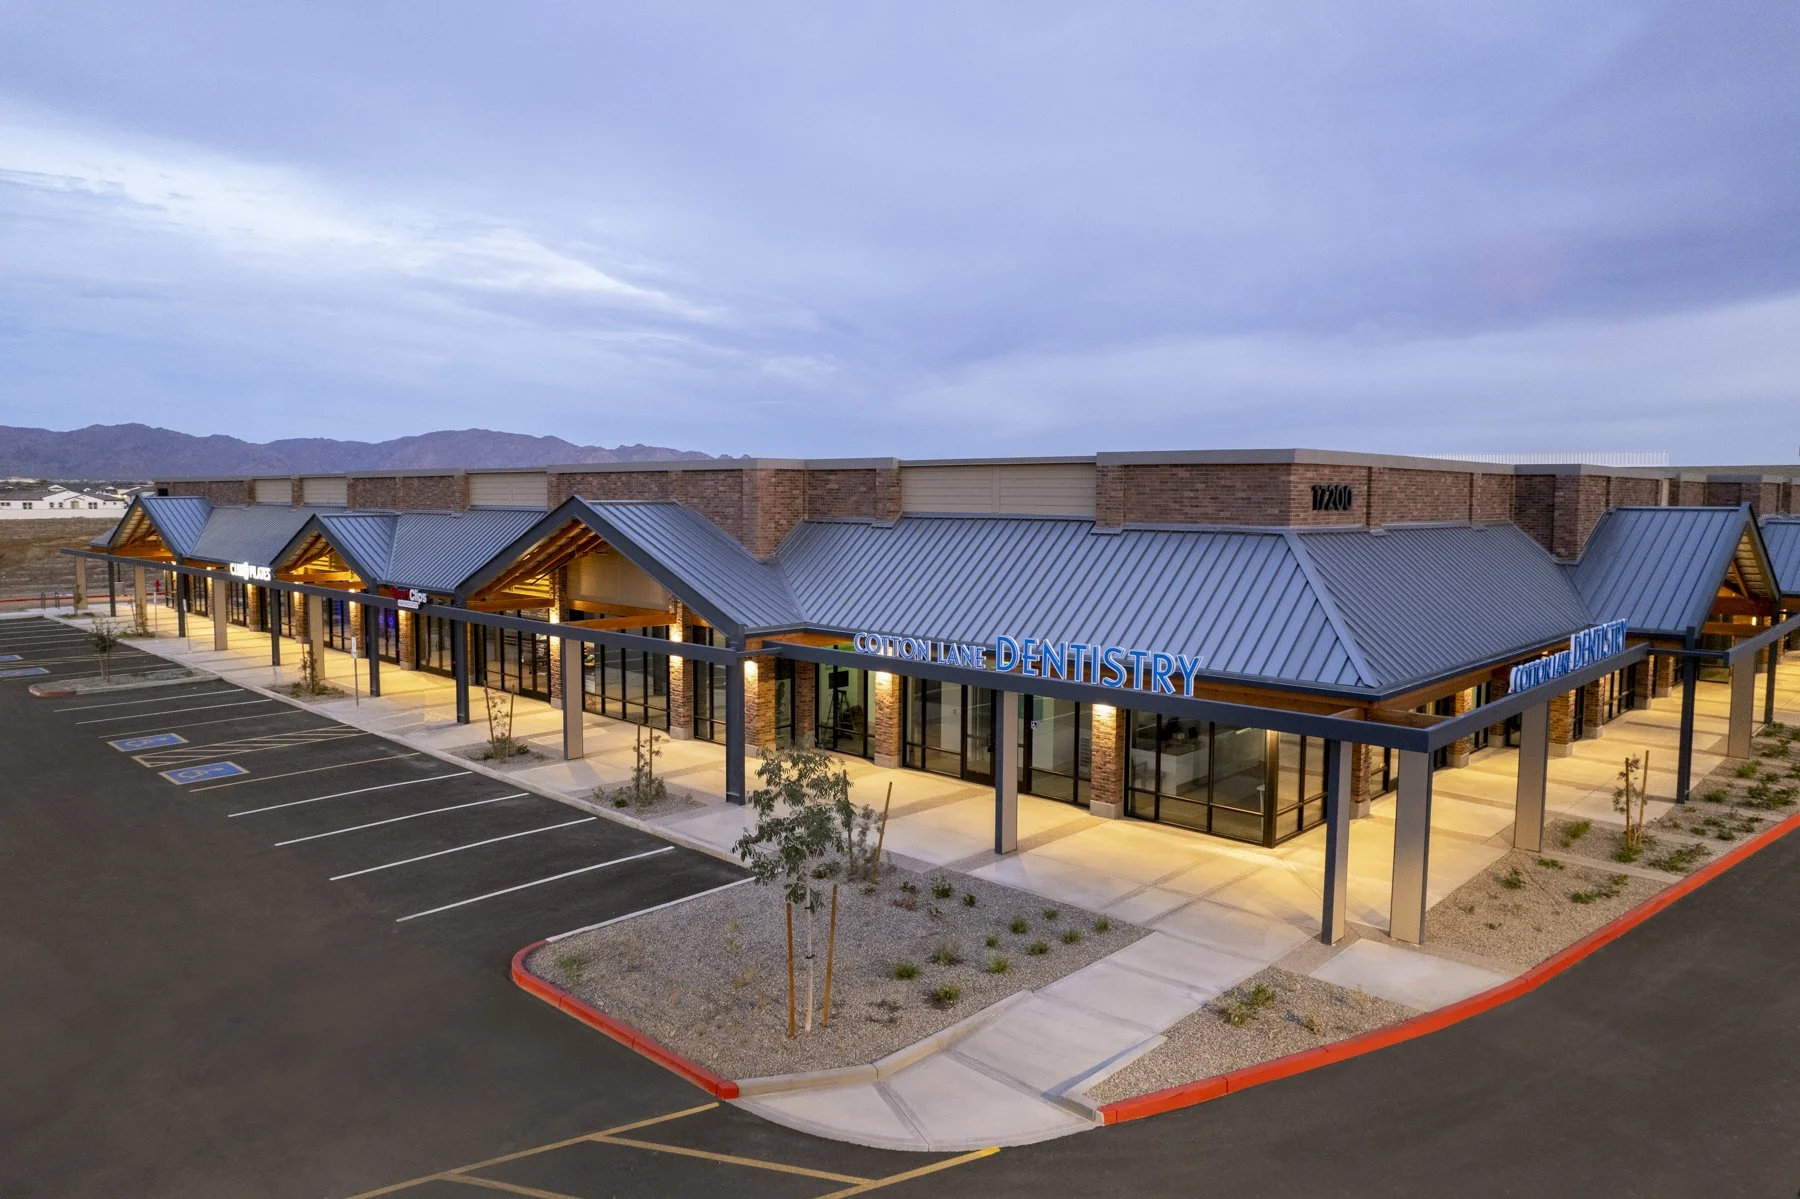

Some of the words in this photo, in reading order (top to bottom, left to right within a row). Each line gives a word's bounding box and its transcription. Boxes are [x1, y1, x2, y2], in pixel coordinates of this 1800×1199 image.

[1311, 484, 1352, 511] 17200
[853, 632, 931, 661] COTTON
[937, 641, 987, 669] LANE
[995, 634, 1203, 697] DENTISTRY
[1508, 657, 1551, 693] COTTON
[1570, 618, 1627, 670] DENTISTRY
